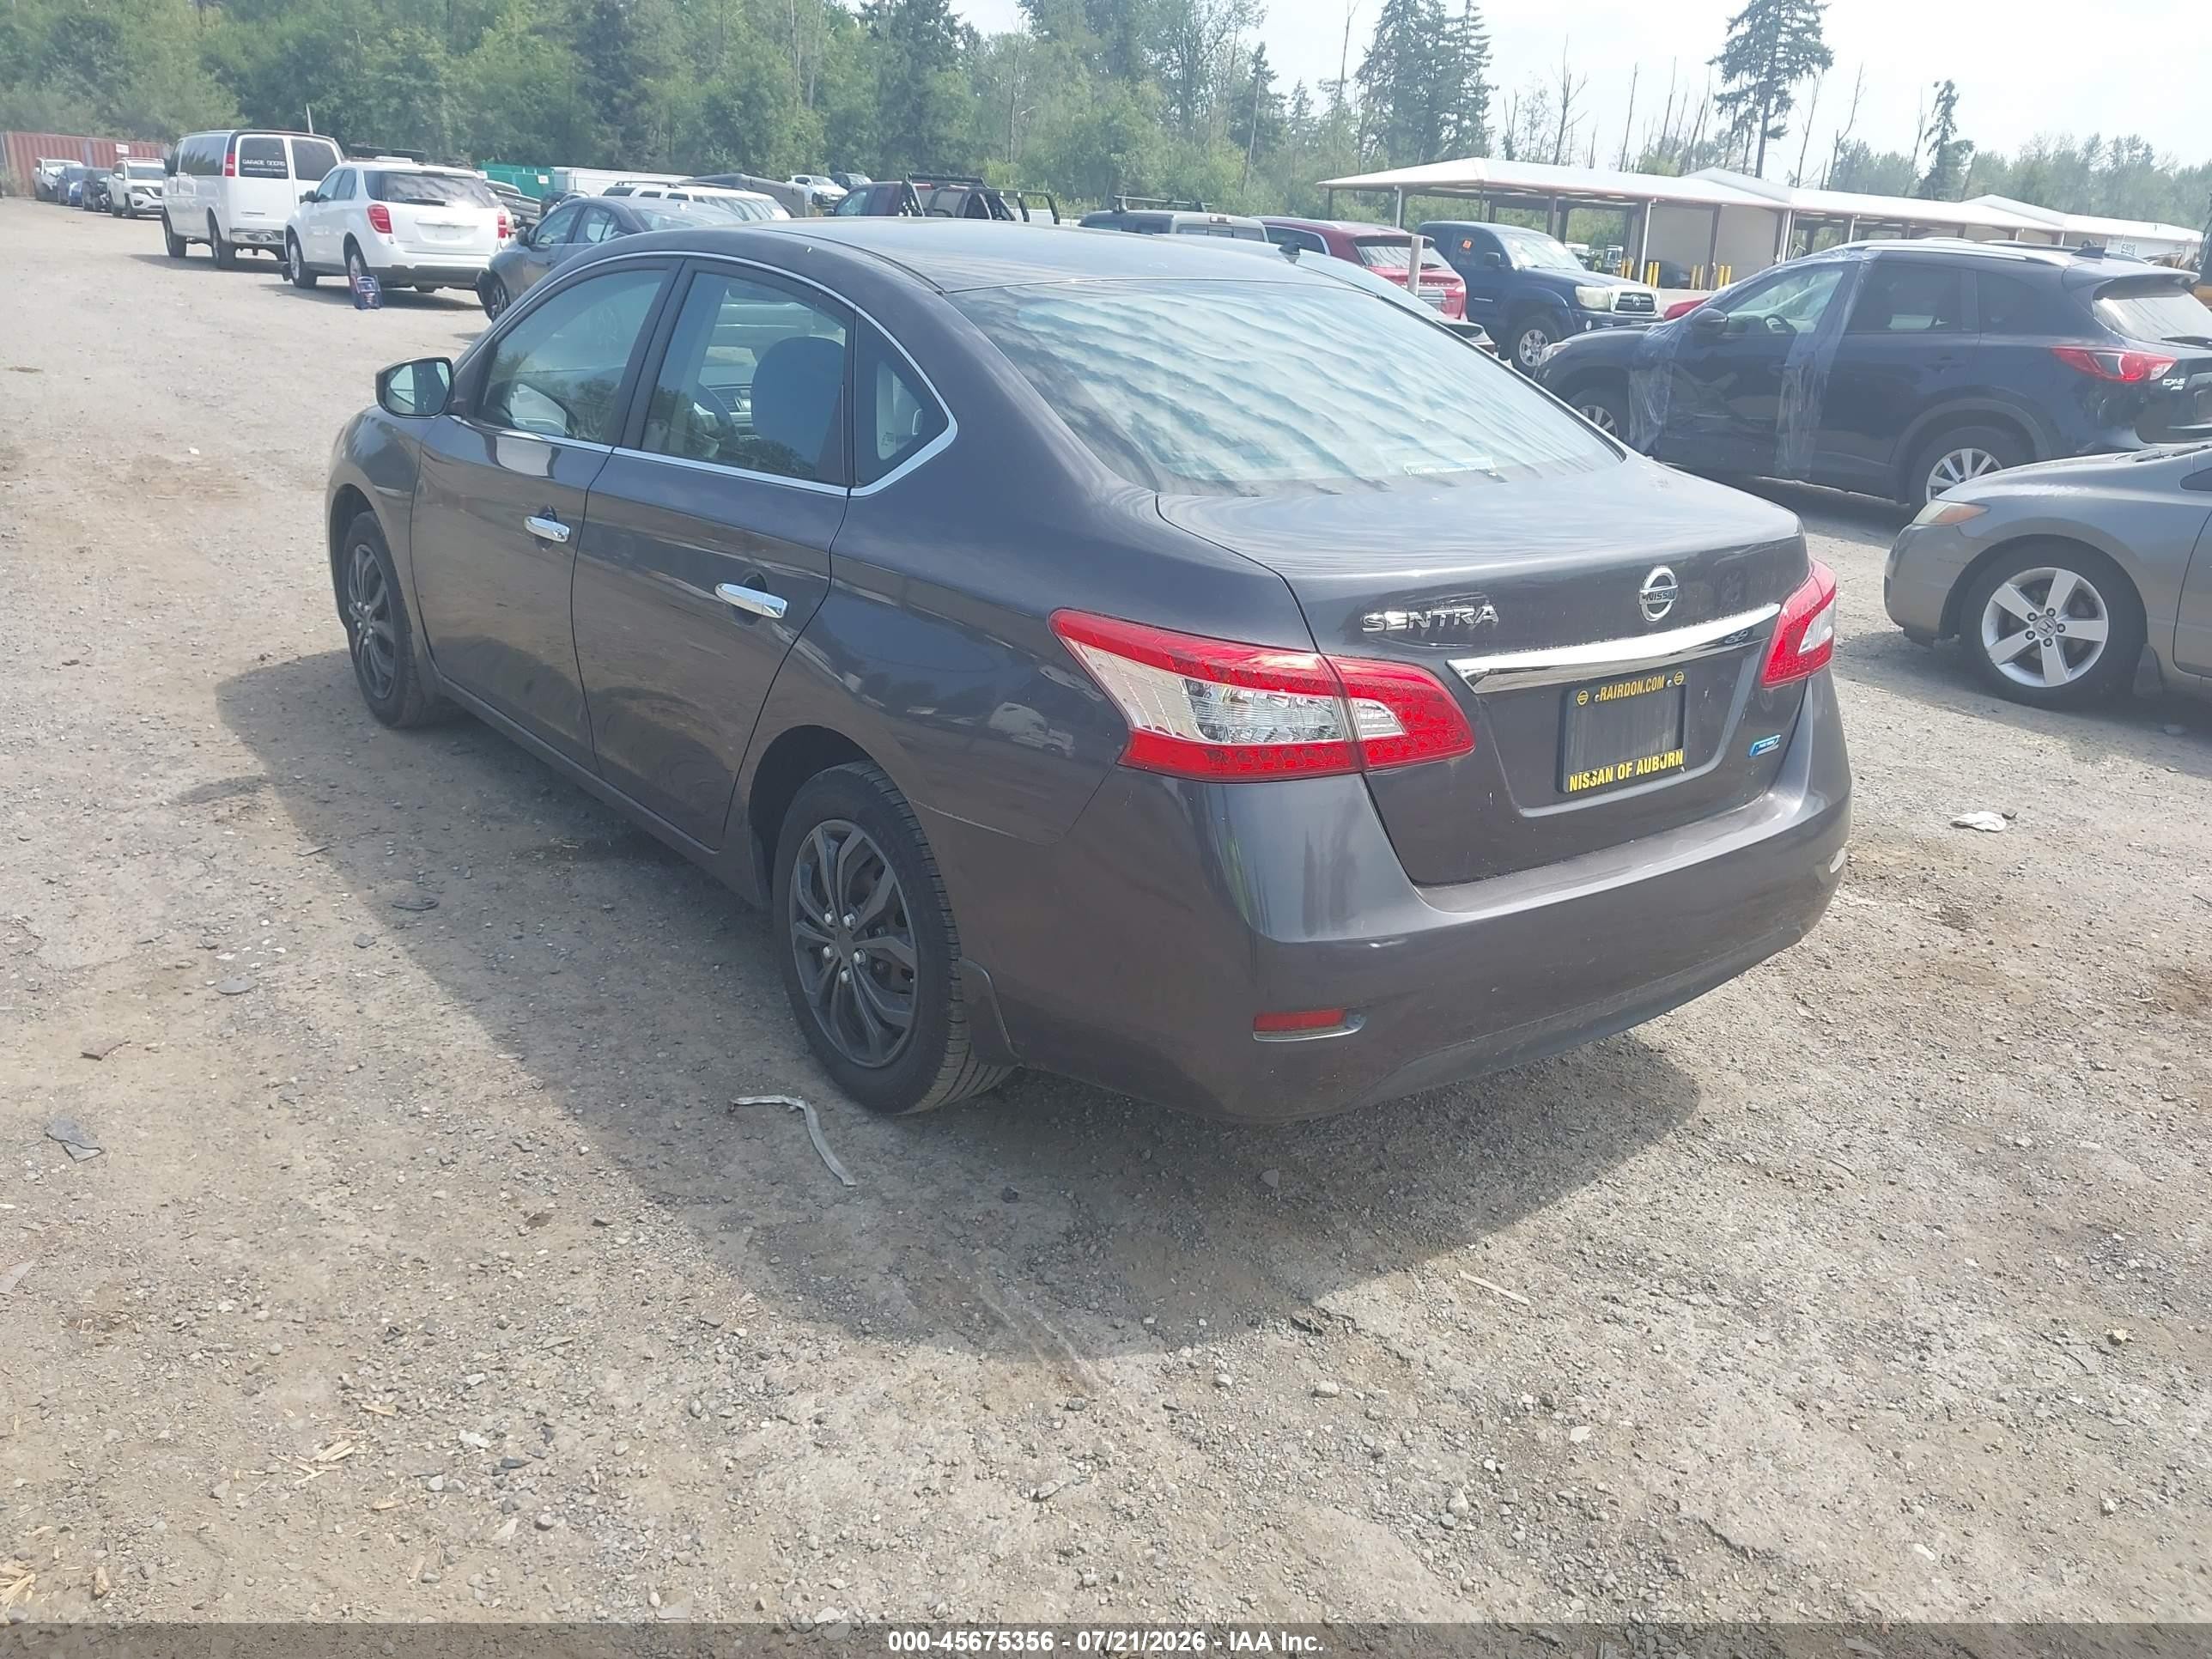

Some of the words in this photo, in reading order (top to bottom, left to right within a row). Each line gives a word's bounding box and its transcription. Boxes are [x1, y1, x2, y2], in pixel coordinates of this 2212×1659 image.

[1361, 604, 1498, 633] SENTRA
[1600, 675, 1665, 702] RAIRDON.COM
[1569, 767, 1613, 792] NISSAN
[1617, 763, 1633, 780] OF
[1636, 750, 1684, 775] AUBURN
